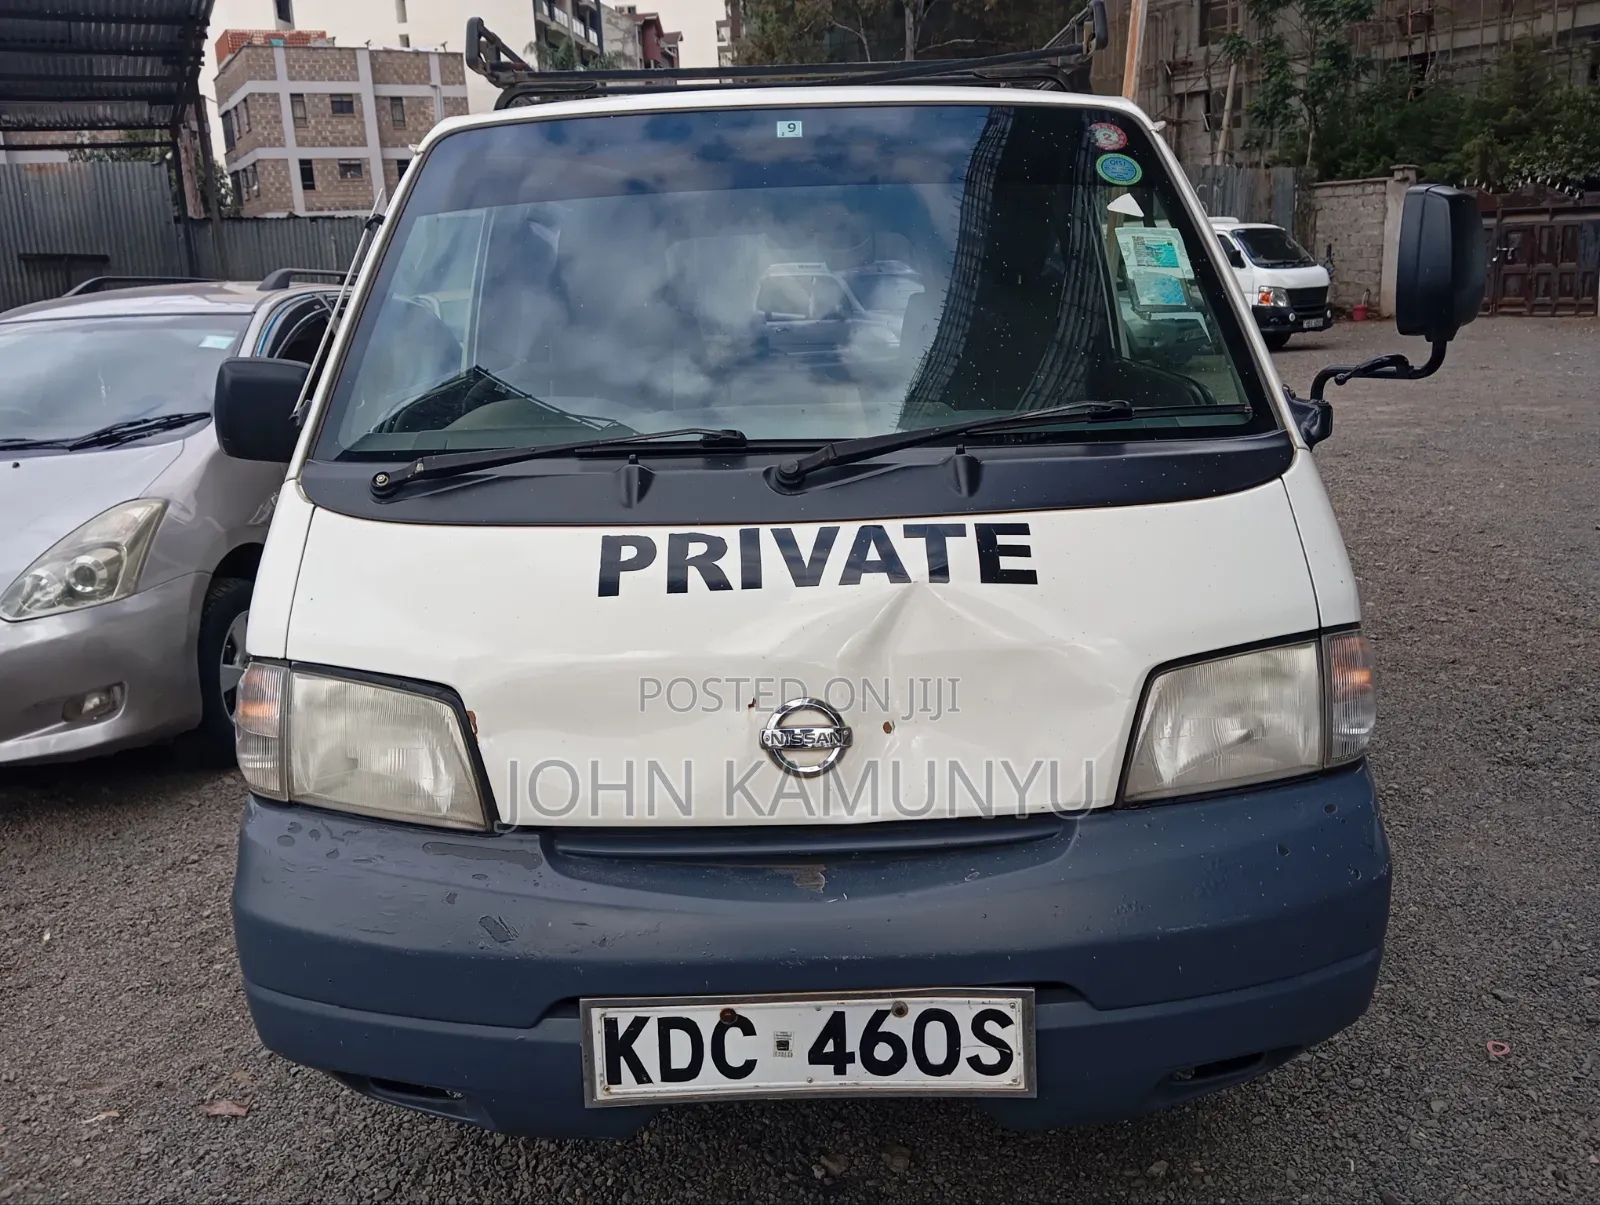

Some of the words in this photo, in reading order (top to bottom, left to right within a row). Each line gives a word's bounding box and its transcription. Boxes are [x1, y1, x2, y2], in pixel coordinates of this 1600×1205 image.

[787, 122, 797, 133] 9
[598, 523, 1038, 597] PRIVATE
[770, 731, 843, 746] NISSAN
[604, 1014, 757, 1085] KDC
[807, 1007, 1014, 1077] 460S
